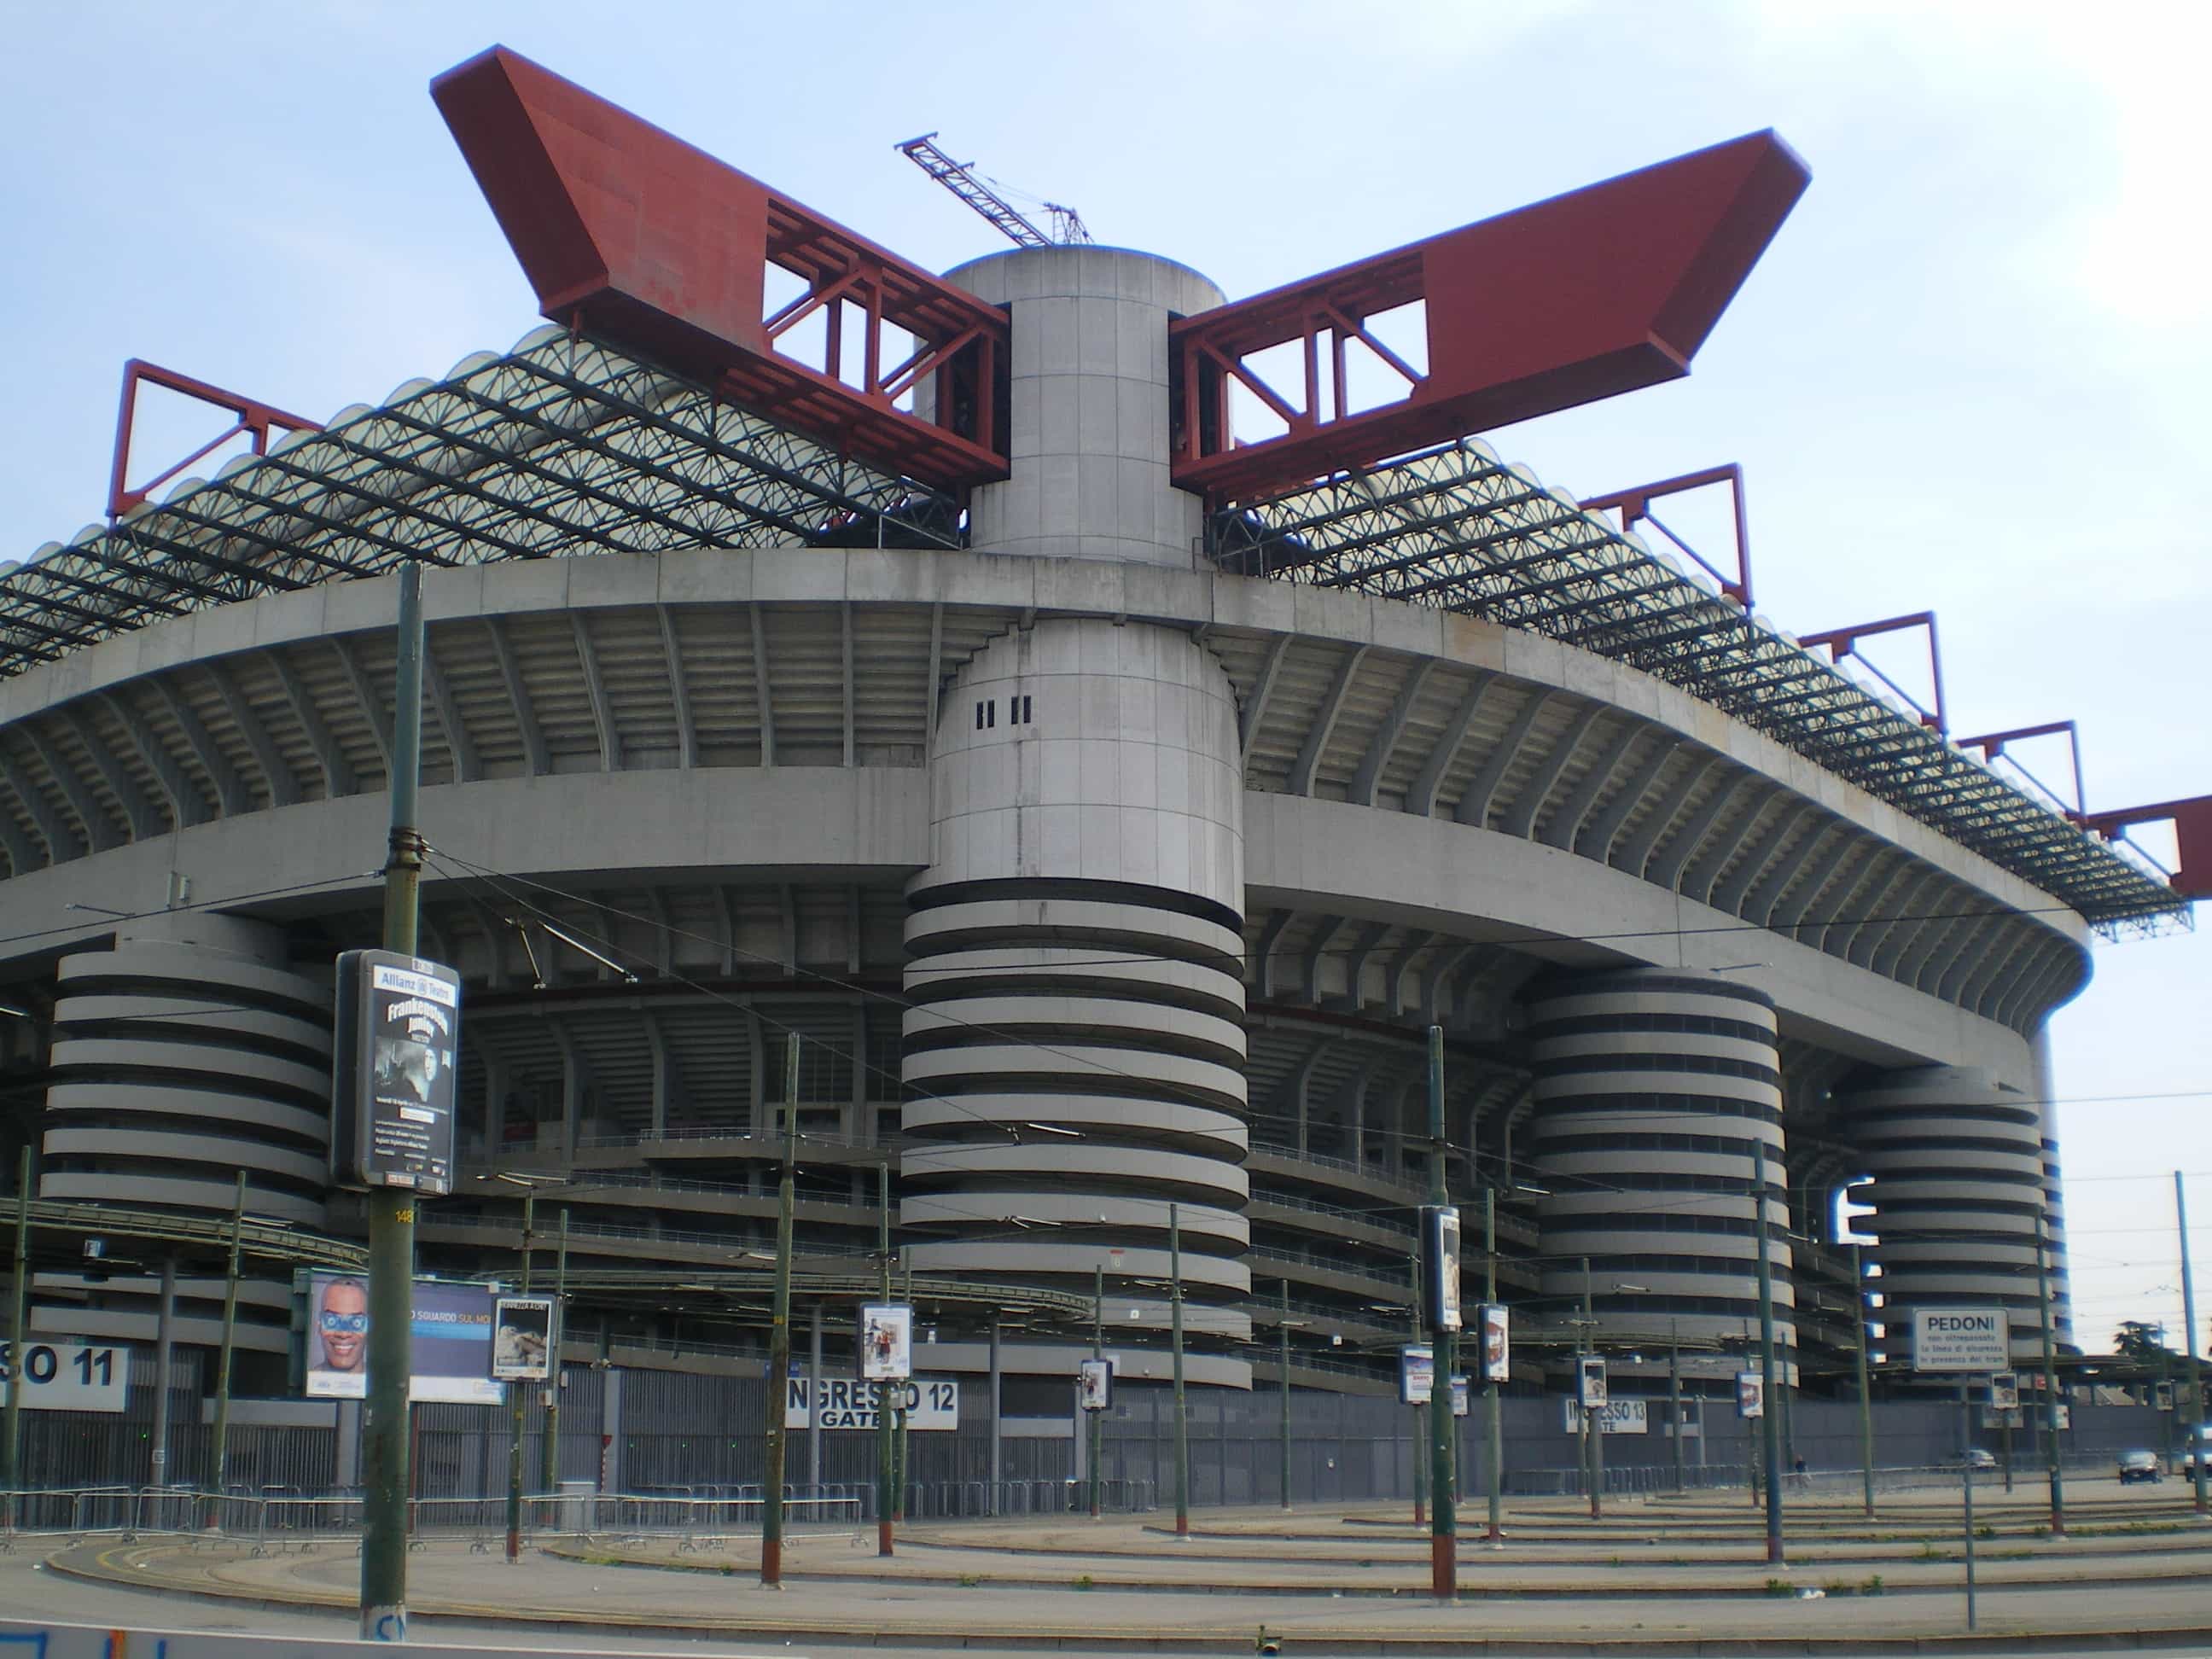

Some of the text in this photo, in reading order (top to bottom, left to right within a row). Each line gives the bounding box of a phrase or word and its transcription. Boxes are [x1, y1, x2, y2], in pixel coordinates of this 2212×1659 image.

[381, 973, 416, 990] Allianz
[417, 1311, 457, 1323] SGUARDO
[1928, 1317, 1994, 1330] PEDONI
[73, 1348, 112, 1386] 11
[789, 1379, 955, 1412] NGRESO 12
[1633, 1402, 1645, 1420] 13
